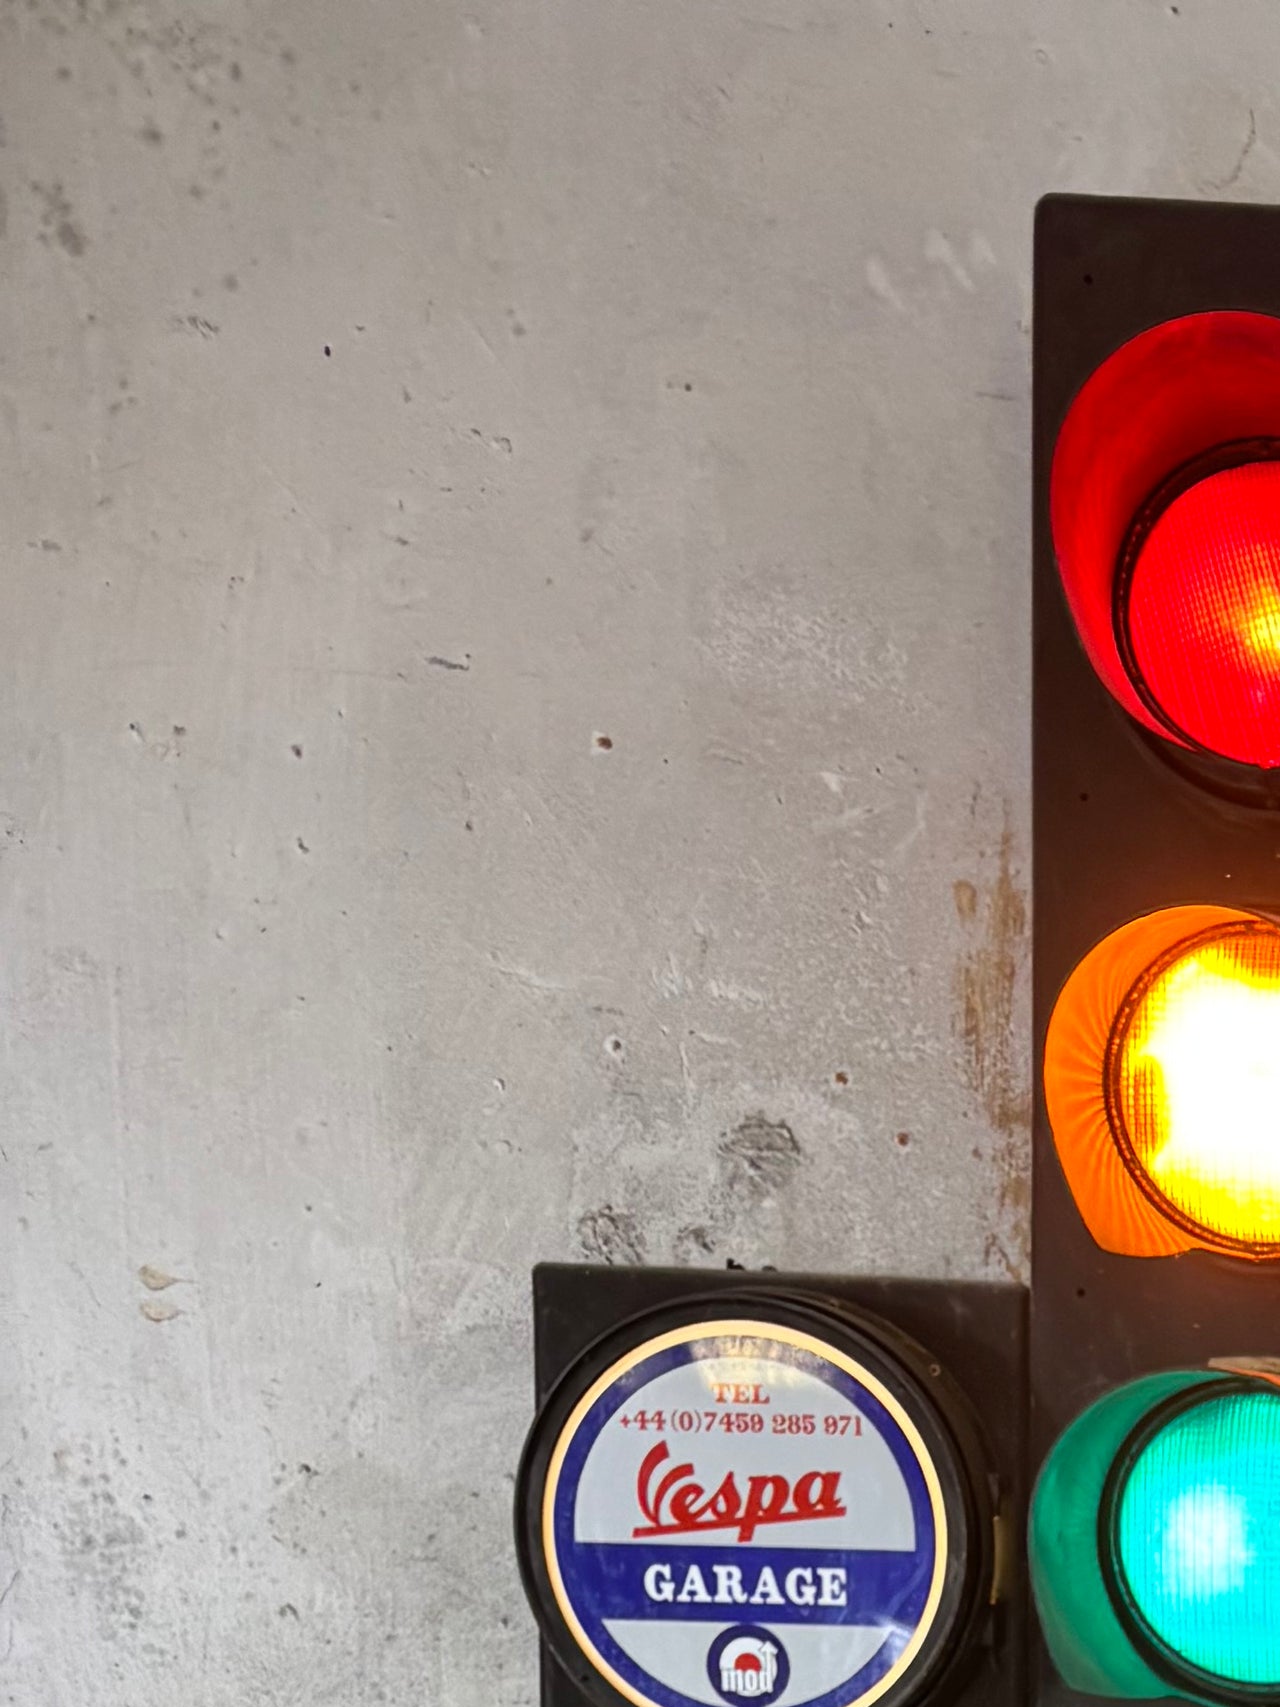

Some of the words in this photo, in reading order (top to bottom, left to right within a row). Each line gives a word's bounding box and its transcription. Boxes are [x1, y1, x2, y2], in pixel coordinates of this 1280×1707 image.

[711, 1382, 770, 1406] TEL
[771, 1413, 816, 1436] 285
[823, 1414, 863, 1437] 971
[631, 1439, 848, 1544] Vespa
[643, 1563, 848, 1607] GARAGE
[720, 1640, 778, 1693] mod
